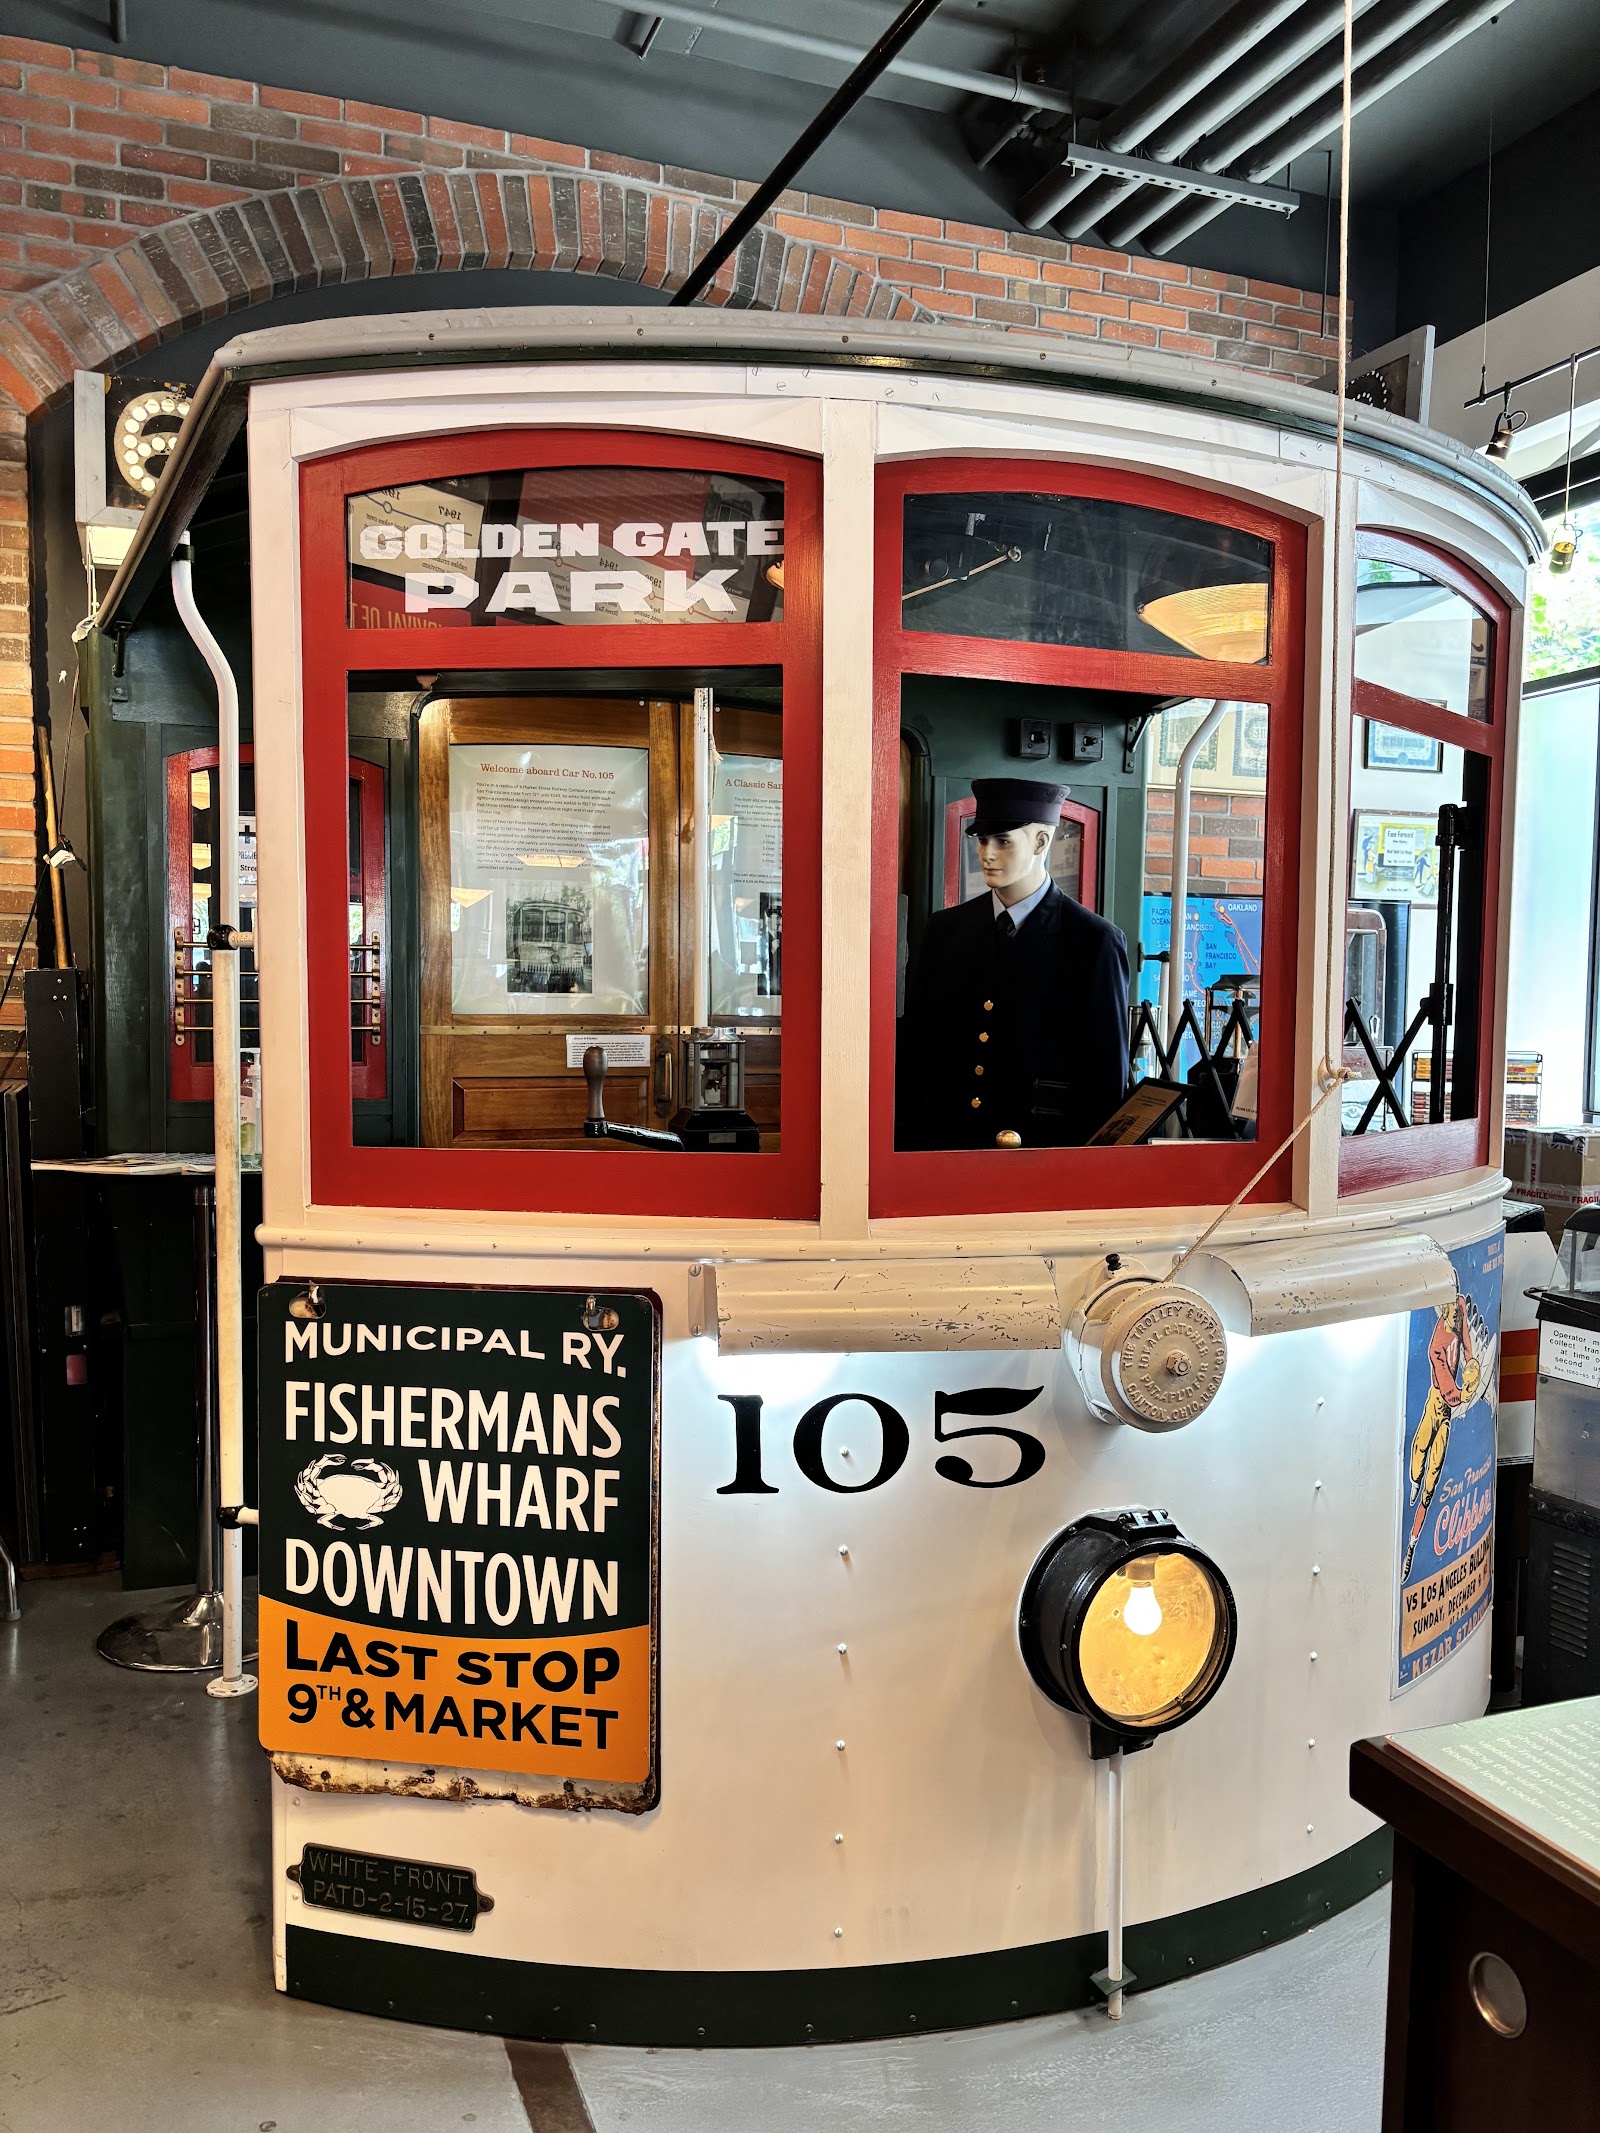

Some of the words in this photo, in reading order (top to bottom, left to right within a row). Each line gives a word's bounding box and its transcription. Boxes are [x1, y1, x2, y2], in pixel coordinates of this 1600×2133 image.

[360, 522, 599, 560] GOLDEN
[613, 520, 784, 558] GATE
[405, 568, 739, 613] PARK
[480, 764, 524, 774] Welcome
[526, 767, 560, 776] aboard
[562, 768, 580, 778] Car
[582, 770, 597, 778] No.
[599, 772, 614, 780] 105
[734, 780, 766, 788] Classic
[1228, 904, 1258, 912] OAKLAND
[1516, 1188, 1548, 1200] FRAGILE
[286, 1321, 546, 1364] MUNICIPAL
[562, 1332, 627, 1378] RY.
[1123, 1343, 1136, 1370] THE
[1131, 1306, 1182, 1339] TROLLEY
[1186, 1308, 1224, 1345] SUPPLY
[1138, 1332, 1162, 1370] IDEAL
[1164, 1322, 1210, 1357] CATCHER
[1550, 1338, 1576, 1350] collect
[1554, 1330, 1586, 1343] Operator
[1574, 1352, 1590, 1360] time
[1192, 1362, 1210, 1390] FOR
[1555, 1357, 1582, 1368] second
[286, 1380, 622, 1458] FISHERMANS
[716, 1385, 1046, 1494] 105
[418, 1459, 620, 1533] WHARF
[1439, 1478, 1464, 1502] San
[286, 1538, 618, 1626] DOWNTOWN
[1438, 1562, 1467, 1602] ANGELES
[1448, 1578, 1476, 1616] DECEMBER
[286, 1618, 438, 1681] LAST
[456, 1646, 620, 1695] STOP
[1412, 1636, 1452, 1680] KEZAR
[1456, 1594, 1489, 1646] STADIUM
[385, 1690, 619, 1750] MARKET
[1442, 1746, 1482, 1771] bodies
[1480, 1770, 1508, 1787] look
[1460, 1744, 1495, 1764] along
[1494, 1764, 1514, 1776] the
[1572, 1810, 1592, 1822] try
[1479, 1740, 1532, 1769] updated
[1528, 1769, 1544, 1778] its
[1539, 1778, 1576, 1797] paint
[1544, 1751, 1598, 1781] windows
[308, 1851, 469, 1896] WHITE-FRONT
